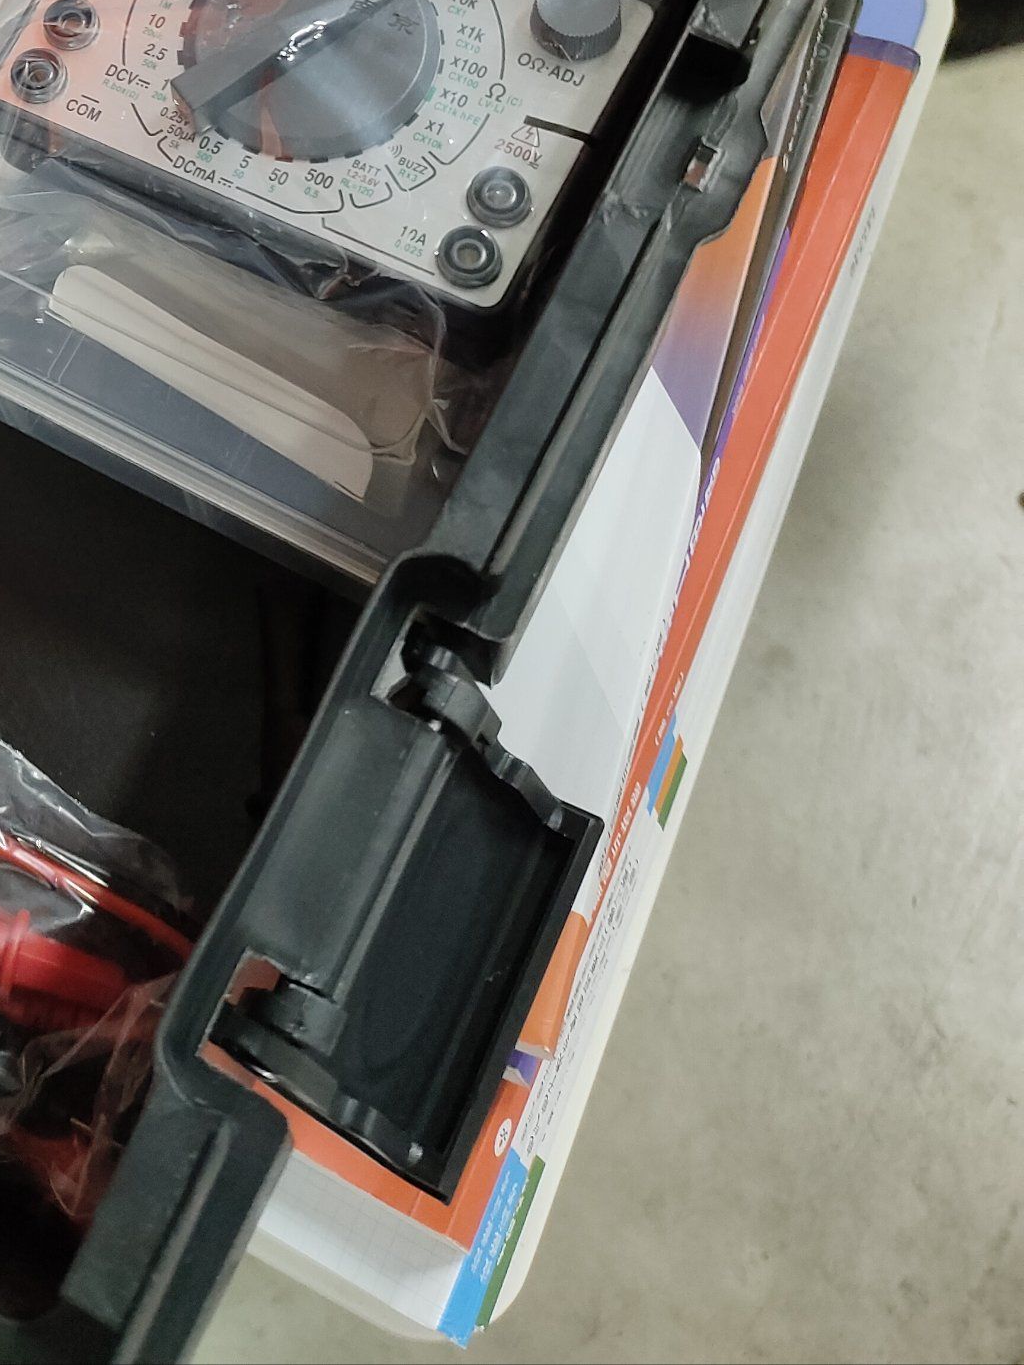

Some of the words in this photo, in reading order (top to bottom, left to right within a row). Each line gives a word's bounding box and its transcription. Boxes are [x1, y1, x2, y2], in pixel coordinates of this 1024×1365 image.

[148, 13, 166, 29] 10
[143, 43, 169, 62] 2.5
[484, 83, 507, 103] Ω
[65, 98, 103, 123] COM
[198, 135, 224, 155] 0.5
[196, 150, 213, 163] 500
[239, 155, 252, 169] 5
[397, 156, 429, 175] BUZZ
[268, 167, 289, 186] 50
[351, 159, 382, 176] BATT
[304, 168, 334, 190] 500
[303, 186, 320, 199] 0.5
[400, 225, 427, 247] 10A
